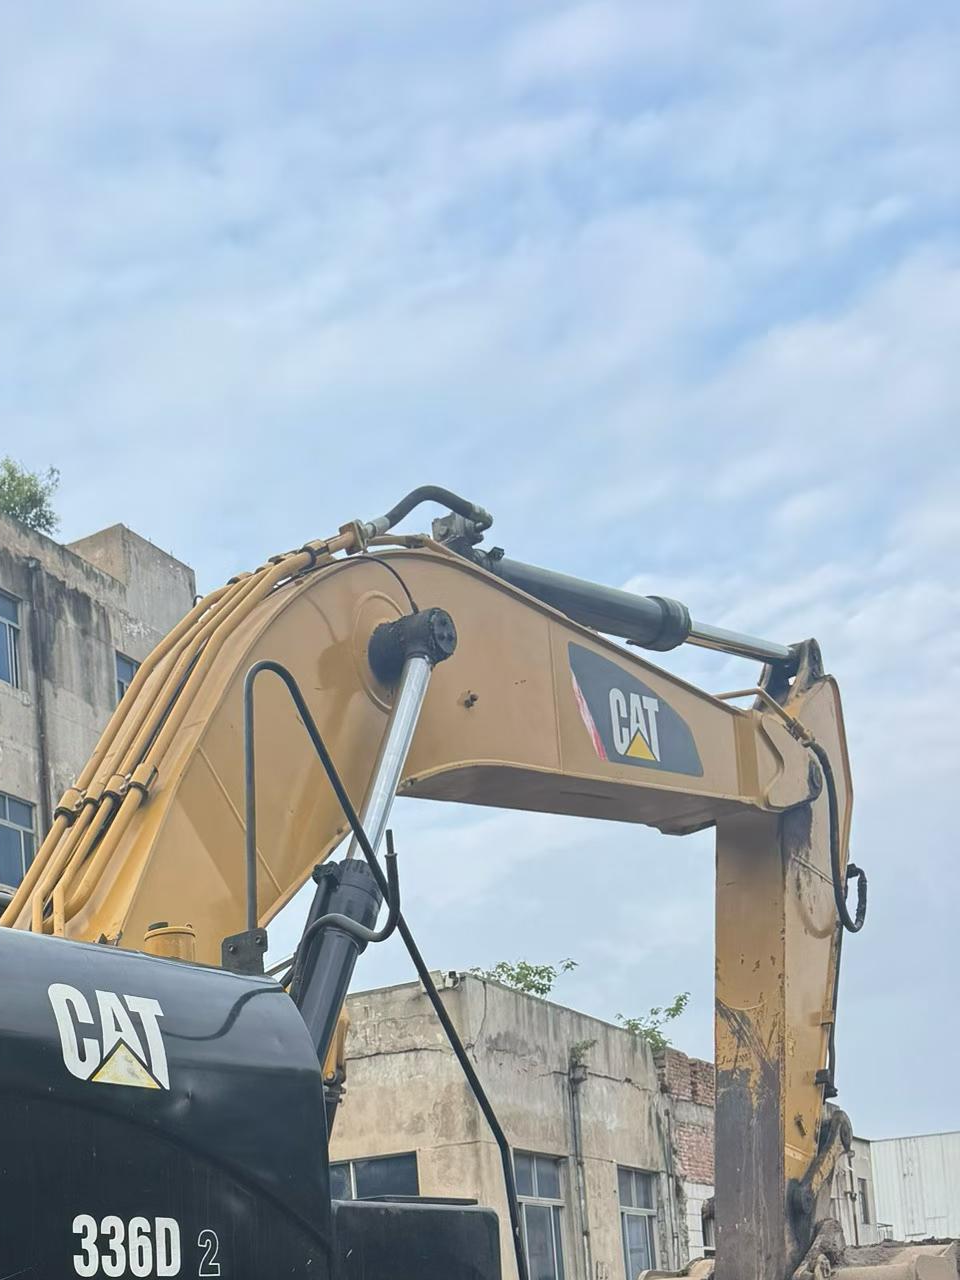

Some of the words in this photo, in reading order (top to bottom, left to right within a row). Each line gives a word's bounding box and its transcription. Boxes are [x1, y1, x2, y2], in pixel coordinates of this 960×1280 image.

[609, 688, 661, 762] CAT
[48, 983, 170, 1090] CAT
[72, 1214, 181, 1278] 336D
[197, 1229, 221, 1277] 2
